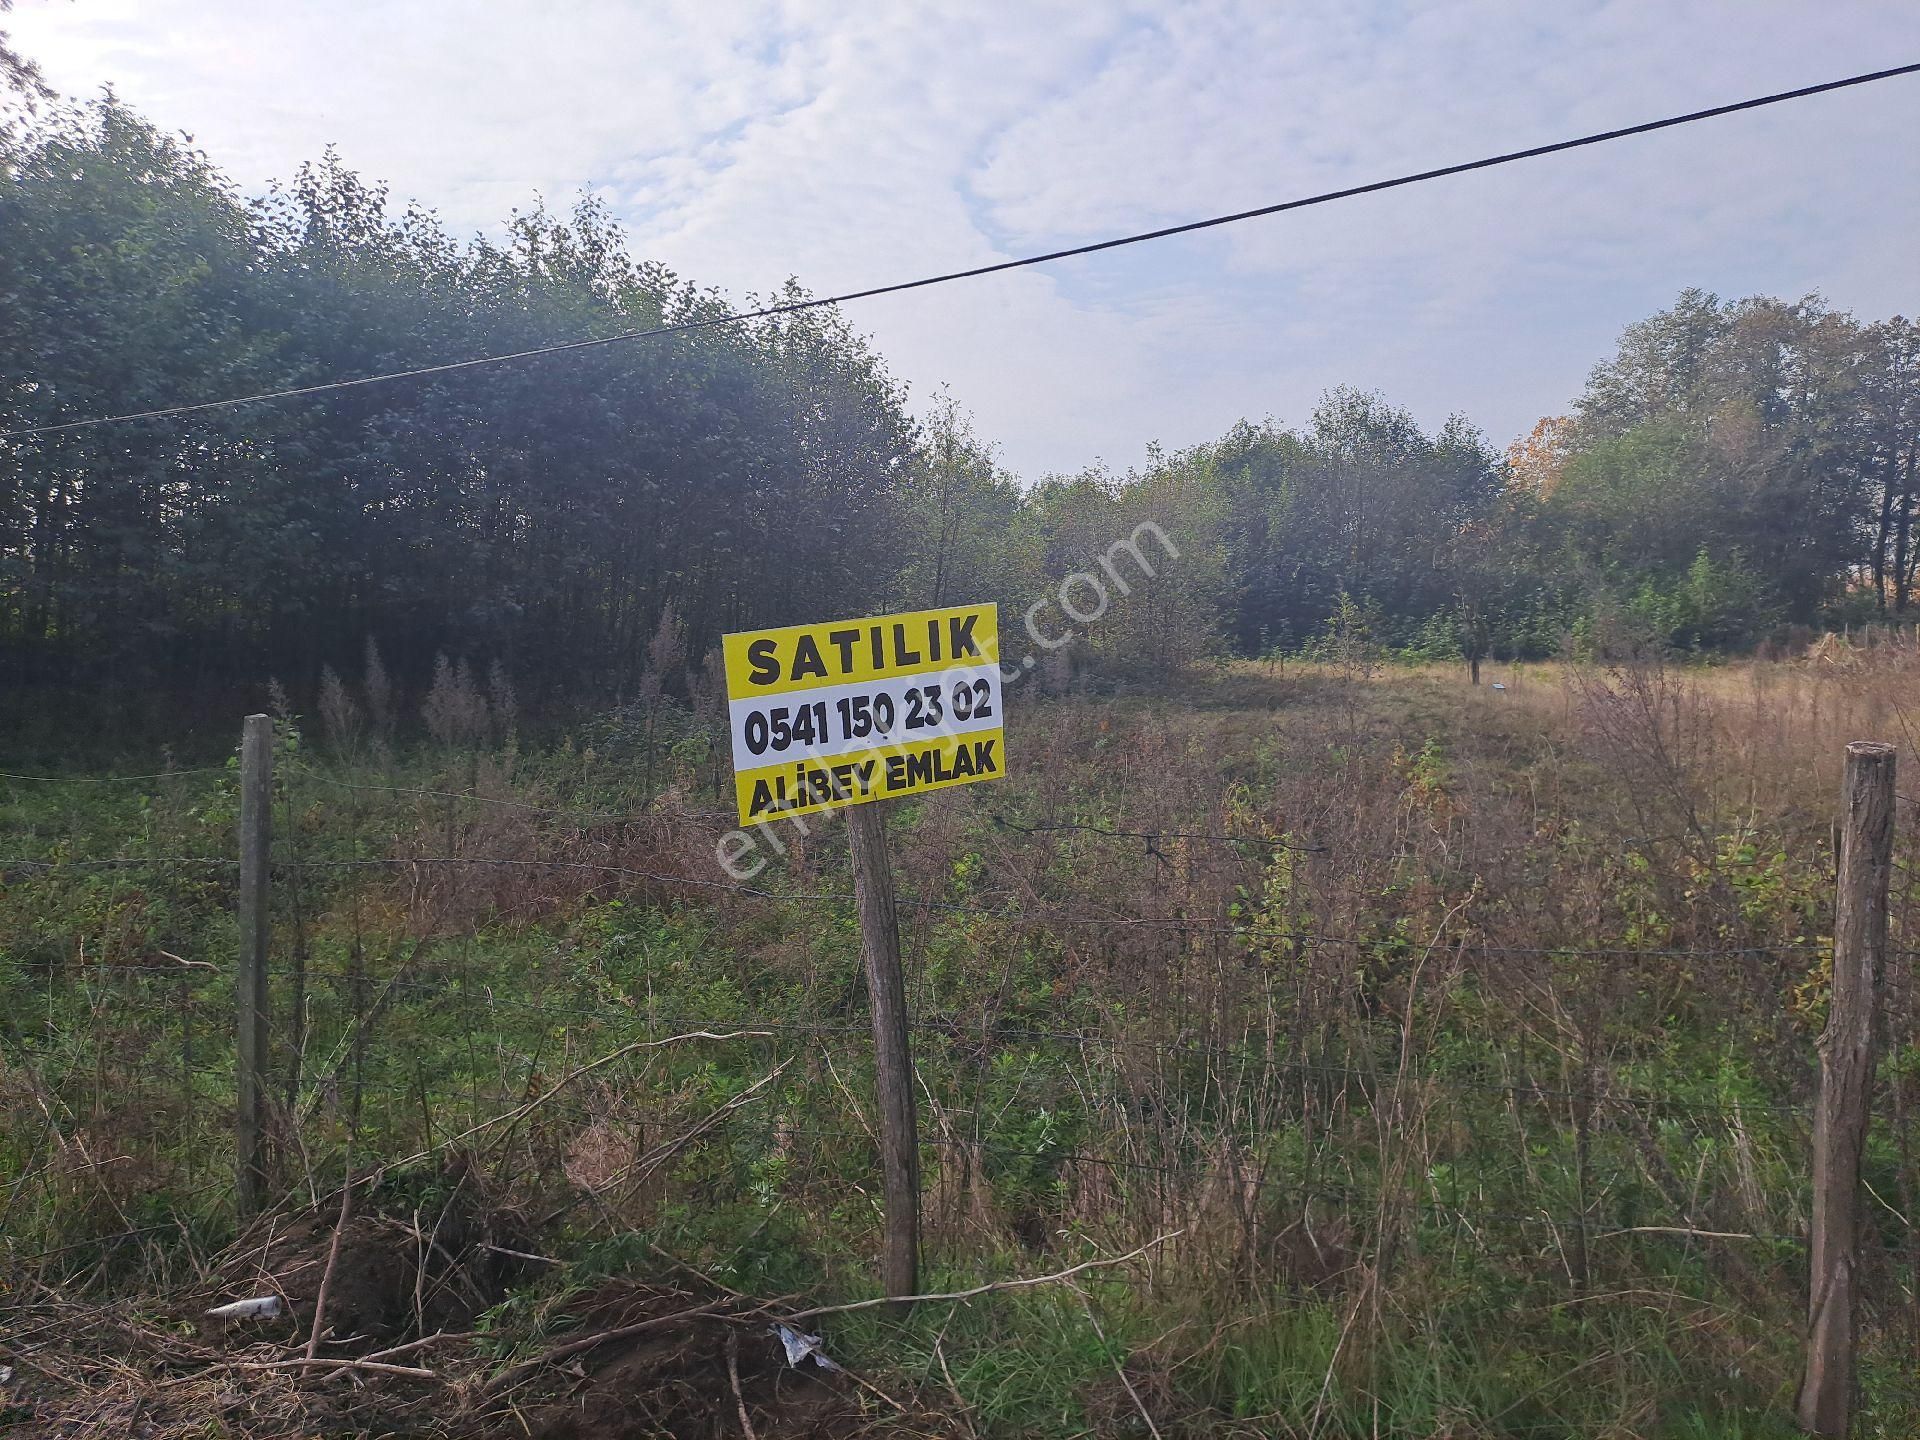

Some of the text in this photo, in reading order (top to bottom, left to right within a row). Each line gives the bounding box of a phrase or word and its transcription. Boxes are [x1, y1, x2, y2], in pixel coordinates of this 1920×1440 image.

[747, 614, 979, 686] SATILIK
[744, 678, 993, 755] 0541 150 23 02
[748, 739, 998, 817] ALİBEY EMLAK
